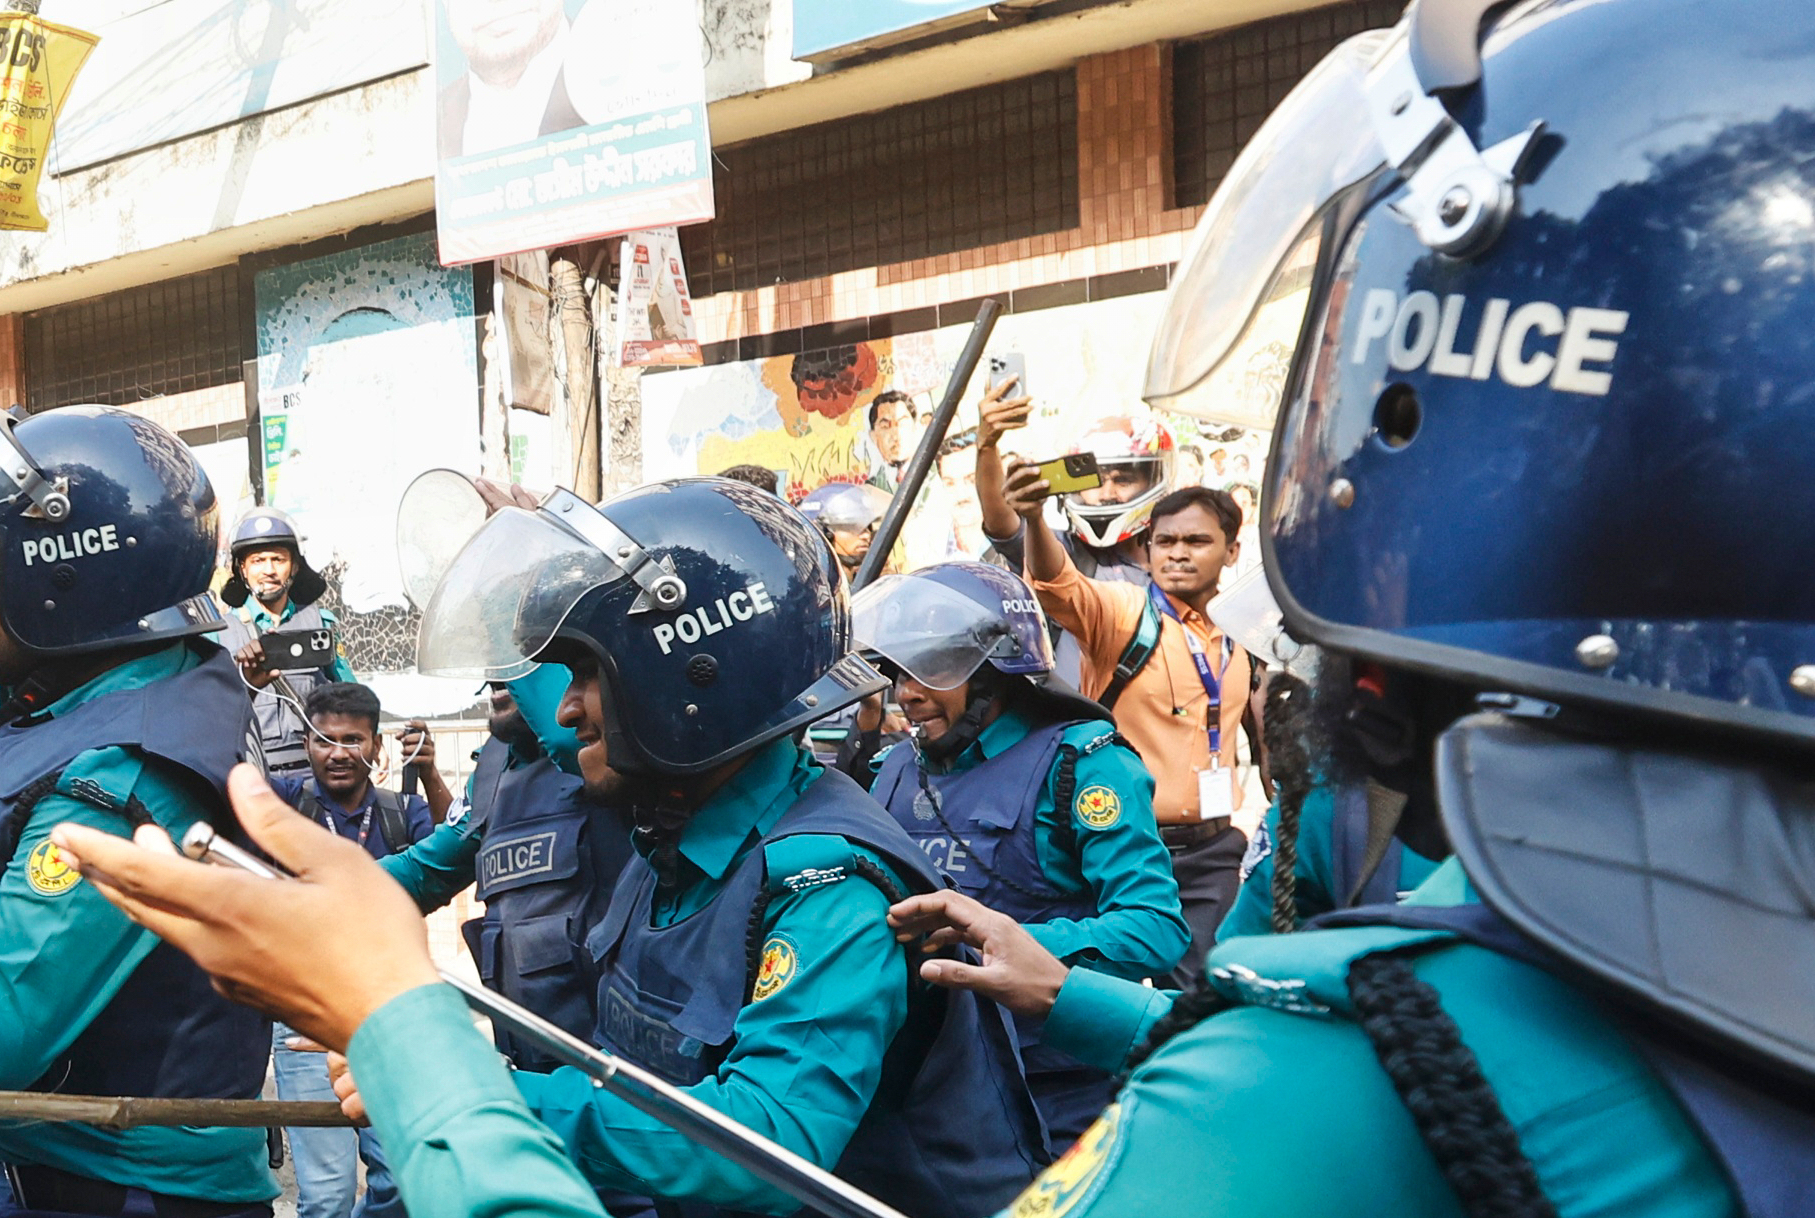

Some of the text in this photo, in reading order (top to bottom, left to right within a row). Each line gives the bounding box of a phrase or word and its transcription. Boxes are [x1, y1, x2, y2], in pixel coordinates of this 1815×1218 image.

[1351, 288, 1630, 396] POLICE
[283, 391, 302, 409] BCS
[22, 524, 120, 566] POLICE
[652, 581, 775, 655] POLICE
[1001, 598, 1038, 614] POLIC
